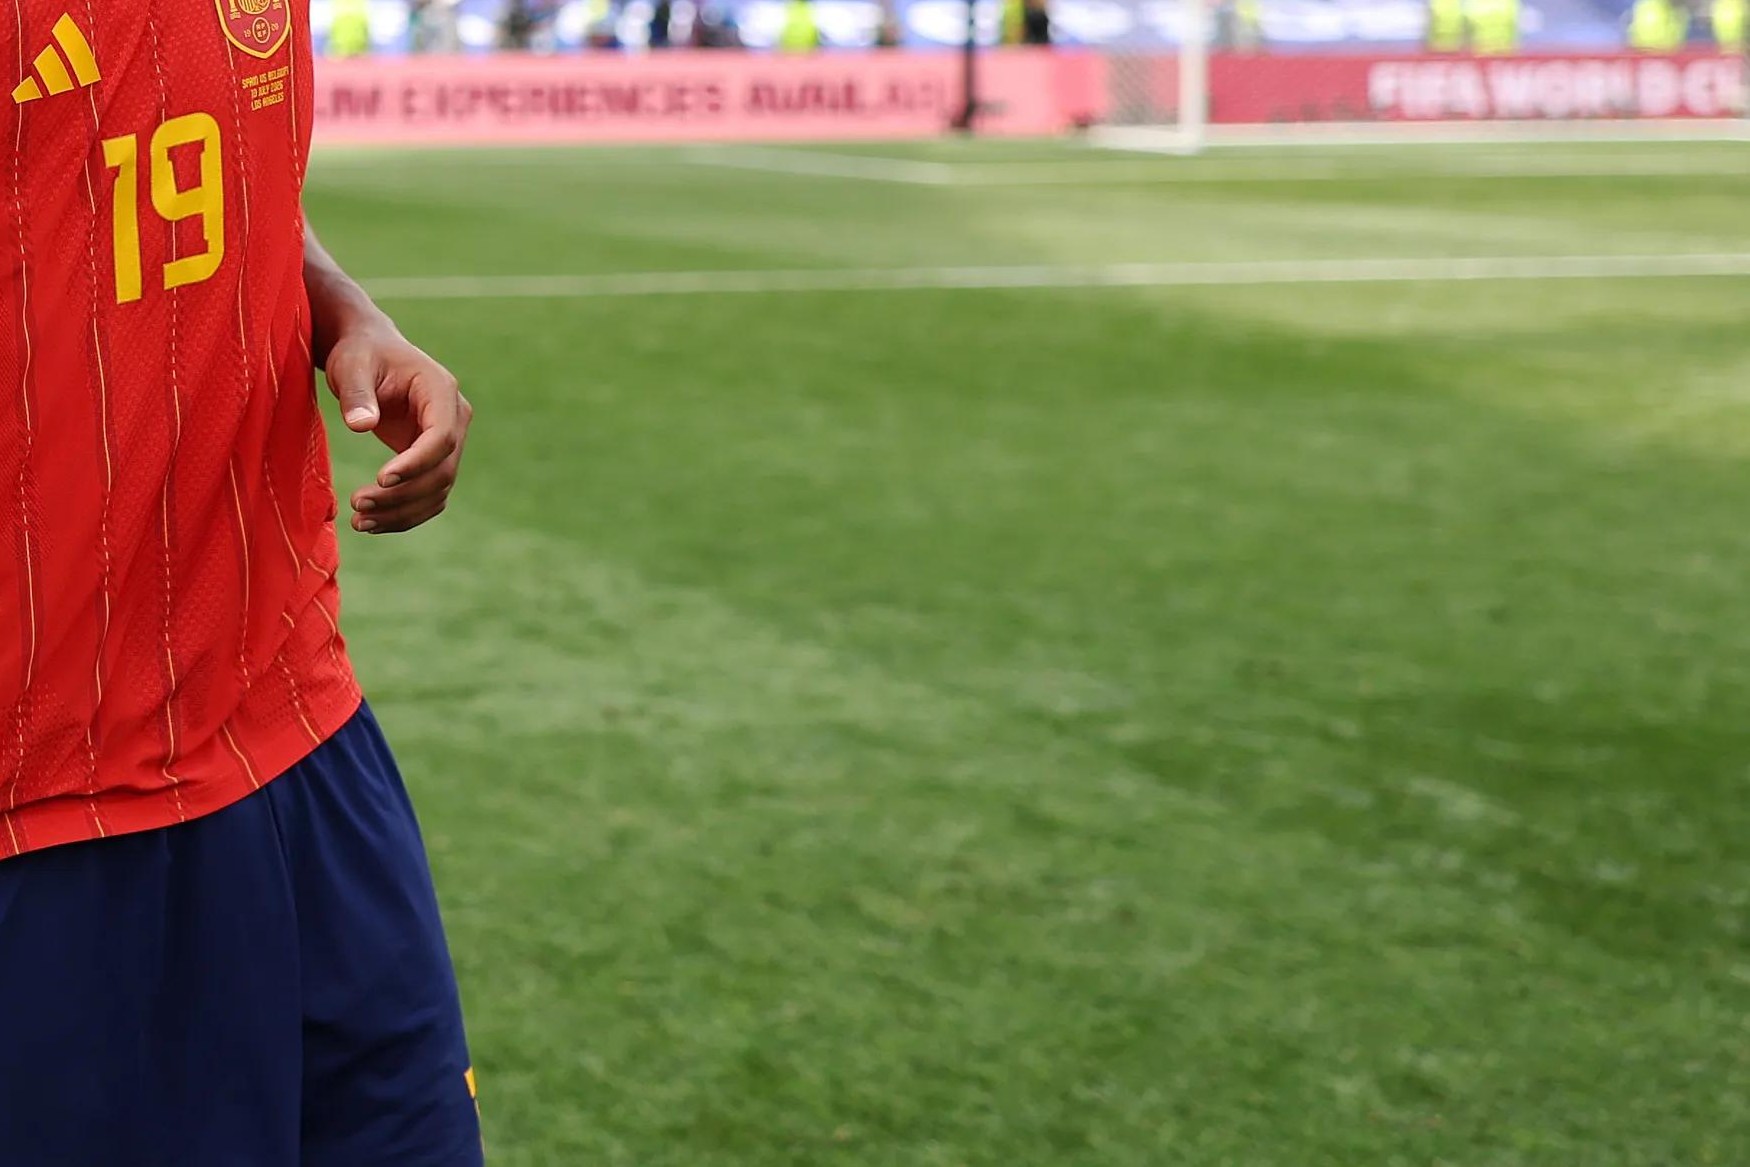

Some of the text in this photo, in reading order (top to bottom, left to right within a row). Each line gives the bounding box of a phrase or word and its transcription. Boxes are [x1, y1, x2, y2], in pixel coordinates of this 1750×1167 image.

[242, 75, 259, 89] SPAIN
[1368, 59, 1489, 118] FIFA
[1489, 59, 1680, 118] WORLD
[102, 113, 224, 304] 19
